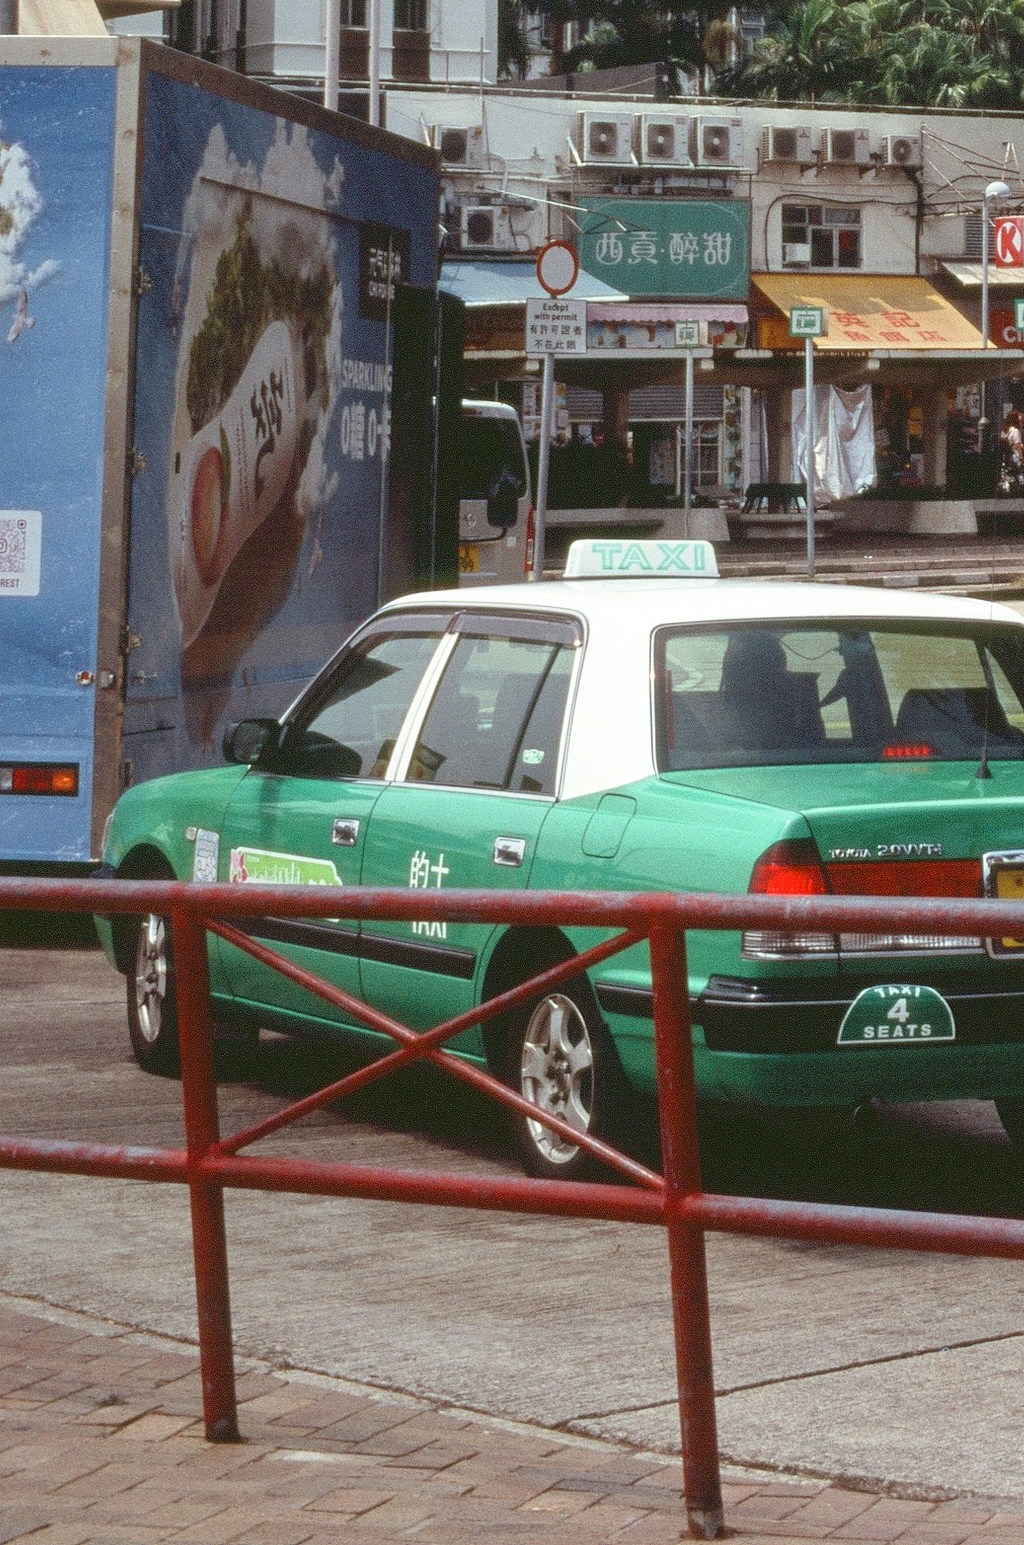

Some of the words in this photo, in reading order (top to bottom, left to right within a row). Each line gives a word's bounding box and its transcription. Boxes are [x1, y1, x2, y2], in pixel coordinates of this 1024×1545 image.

[999, 223, 1021, 262] K
[543, 303, 569, 312] Except
[534, 313, 550, 321] with
[552, 313, 577, 322] permit
[535, 339, 577, 350] 不在此限
[592, 543, 705, 571] TAXI
[829, 849, 871, 858] TOYOTA
[874, 985, 921, 998] TAXI
[887, 998, 909, 1022] 4
[863, 1023, 931, 1039] SEATS
